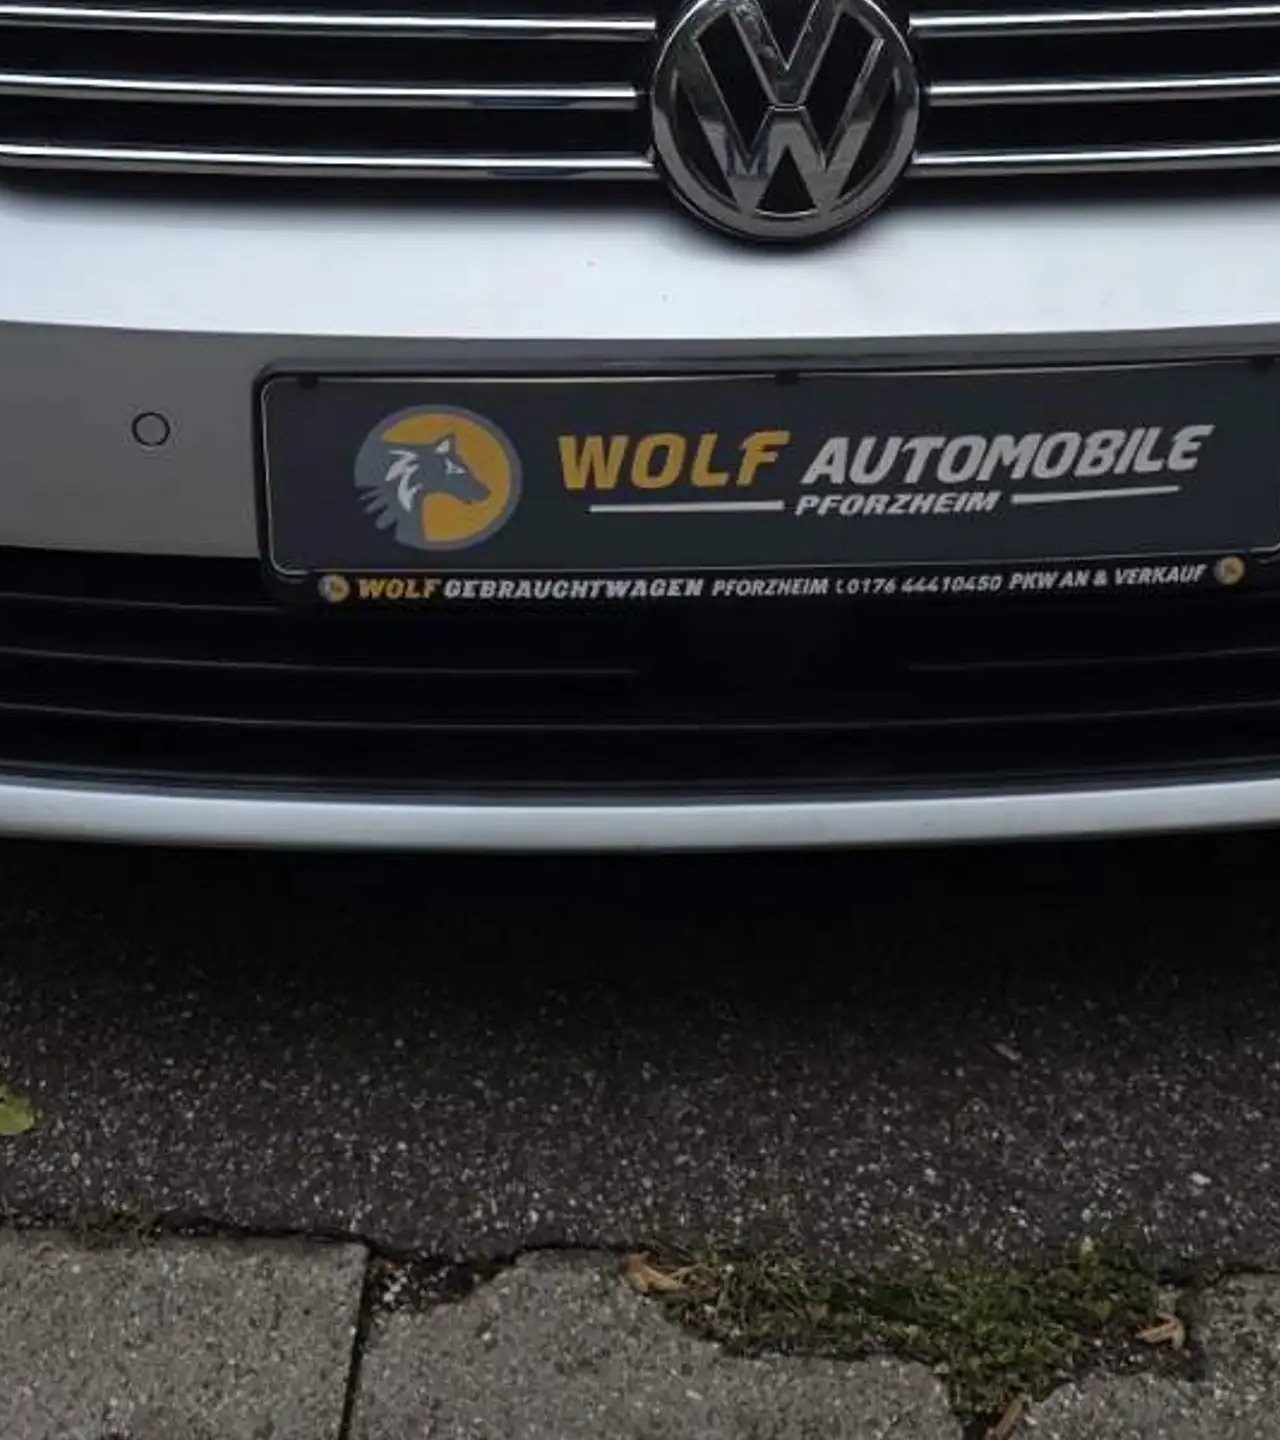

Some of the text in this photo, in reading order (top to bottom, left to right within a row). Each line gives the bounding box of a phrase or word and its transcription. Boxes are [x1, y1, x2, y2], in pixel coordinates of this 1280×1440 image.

[557, 423, 1215, 490] WOLF AUTOMOBILE
[794, 490, 1002, 517] PFORZHEIM
[355, 577, 442, 600] WOLF
[444, 578, 704, 601] GEBRAUCHTWAGEN
[711, 577, 829, 597] PFORZHEIM
[847, 576, 896, 595] 0176
[1009, 570, 1058, 591] PKW
[1093, 569, 1108, 588] &
[1114, 563, 1208, 585] VERKAUF
